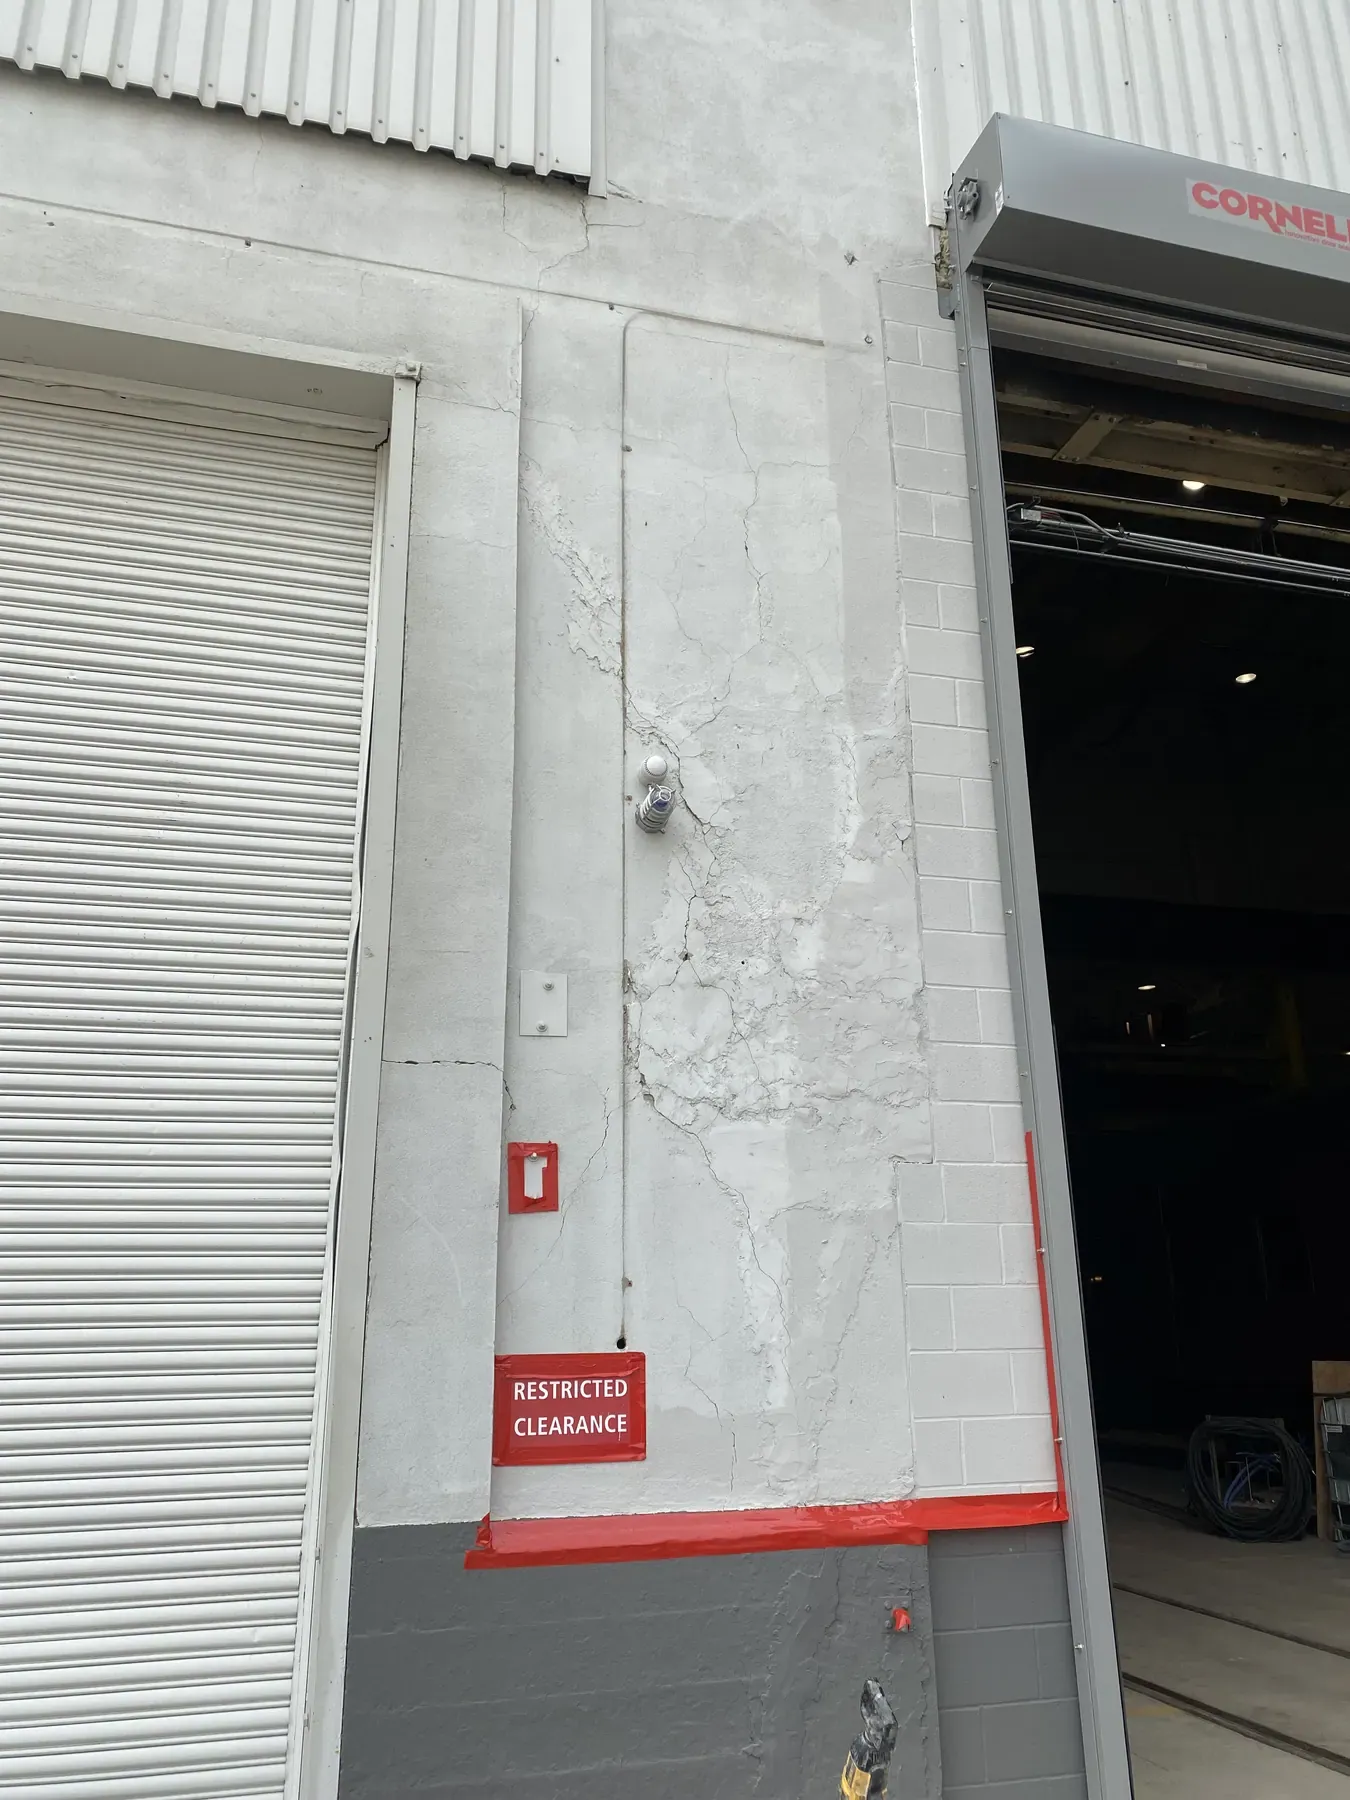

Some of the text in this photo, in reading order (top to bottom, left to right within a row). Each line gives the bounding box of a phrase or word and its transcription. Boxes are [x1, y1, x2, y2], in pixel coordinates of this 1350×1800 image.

[1192, 182, 1350, 246] CORNEL
[514, 1379, 628, 1401] RESTRICTED
[514, 1414, 627, 1437] CLEARANCE
